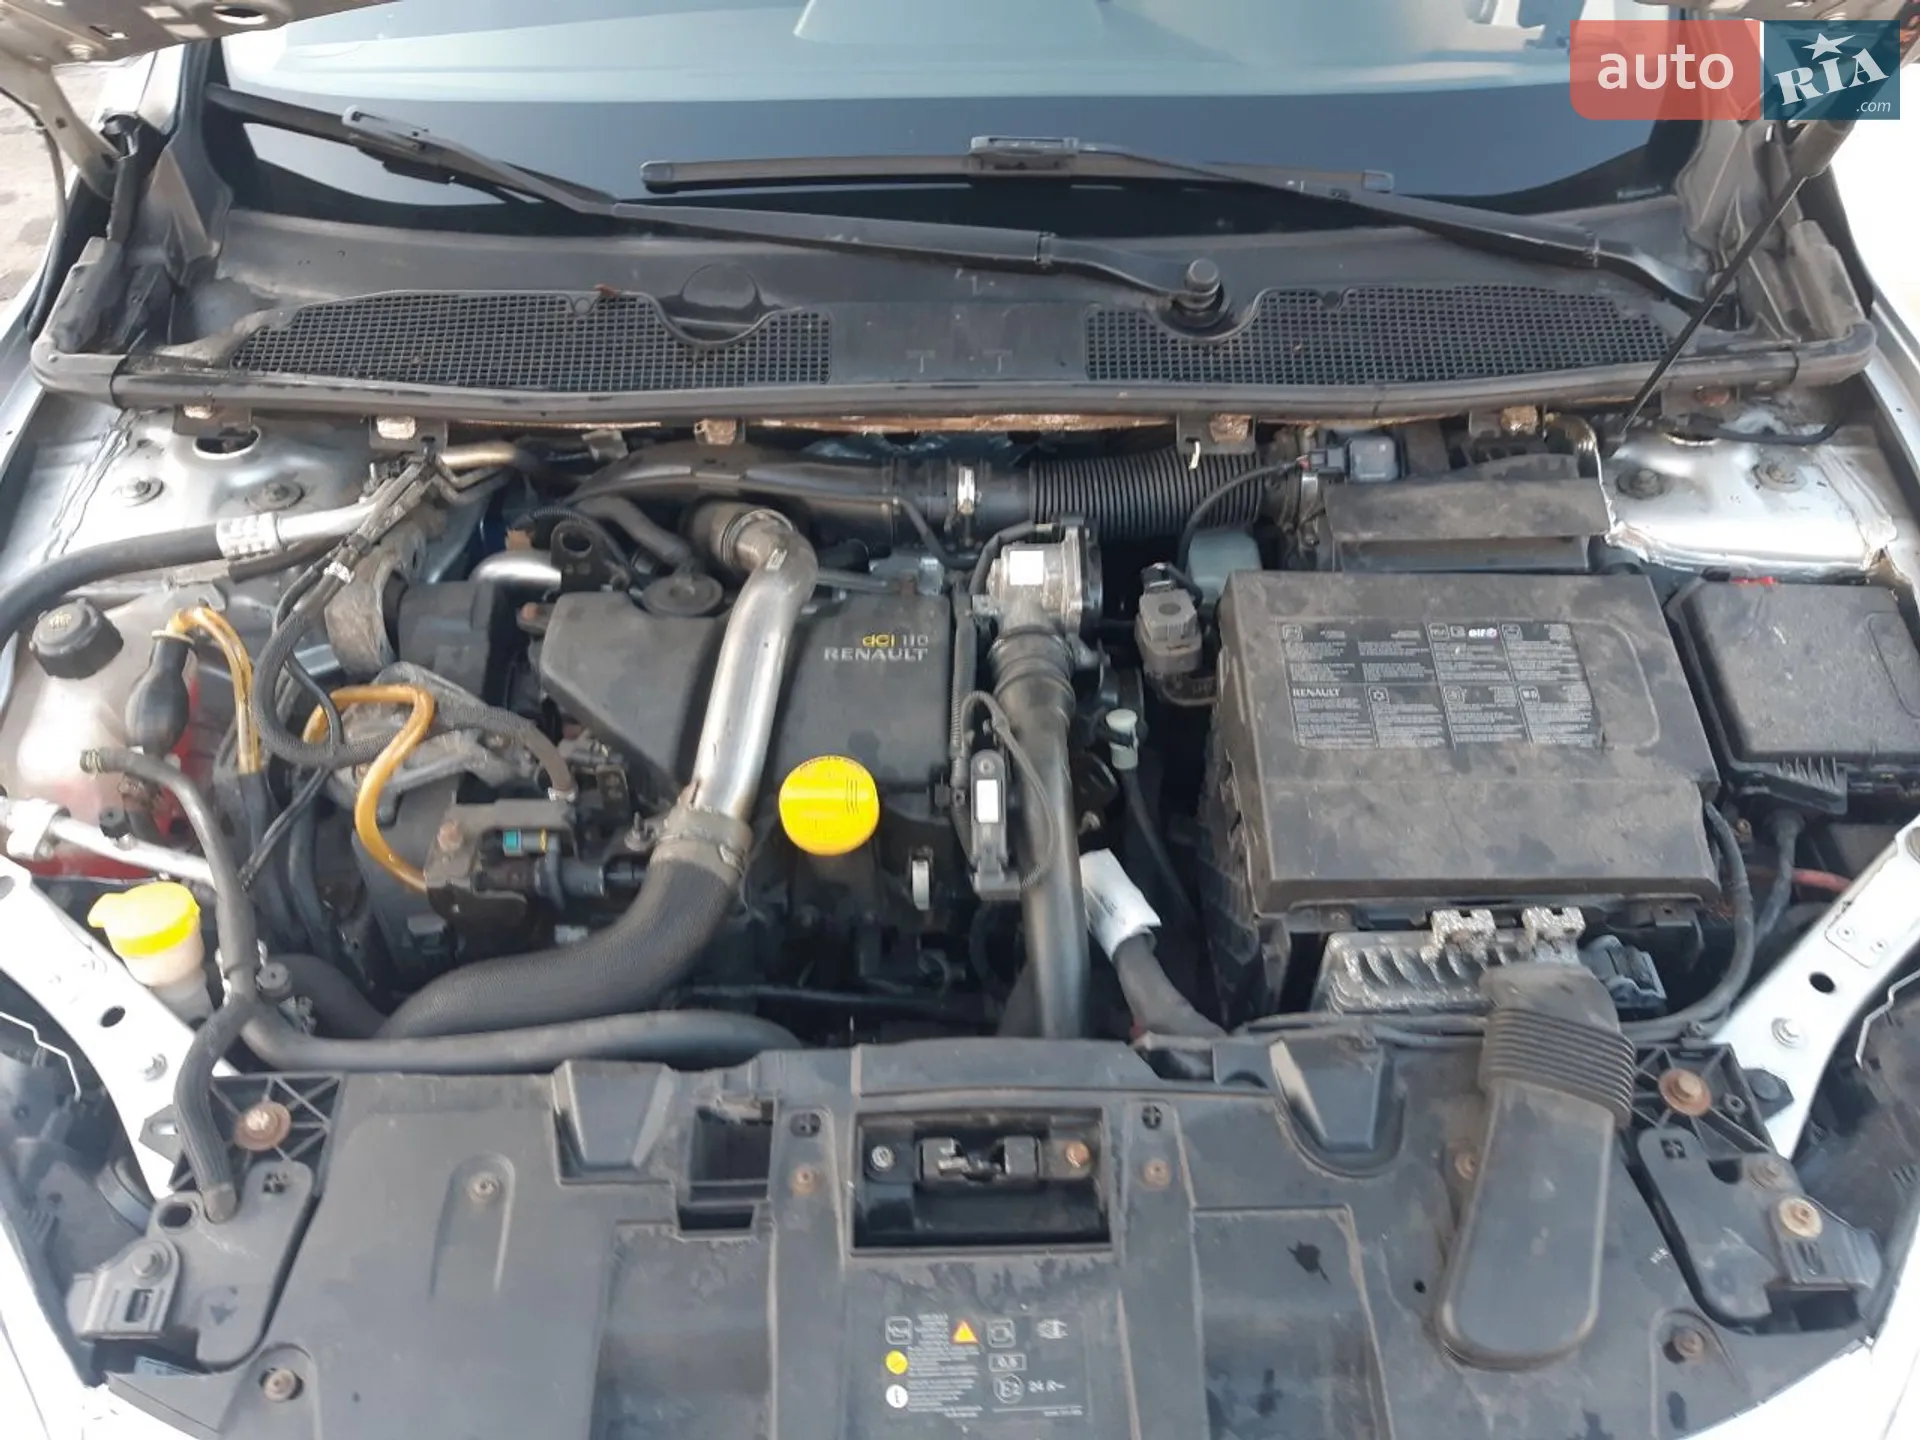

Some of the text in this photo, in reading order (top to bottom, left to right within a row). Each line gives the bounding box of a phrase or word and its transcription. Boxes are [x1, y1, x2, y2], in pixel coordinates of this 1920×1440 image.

[902, 634, 929, 646] 110
[824, 647, 928, 661] RENAULT
[1293, 687, 1341, 698] RENAULT
